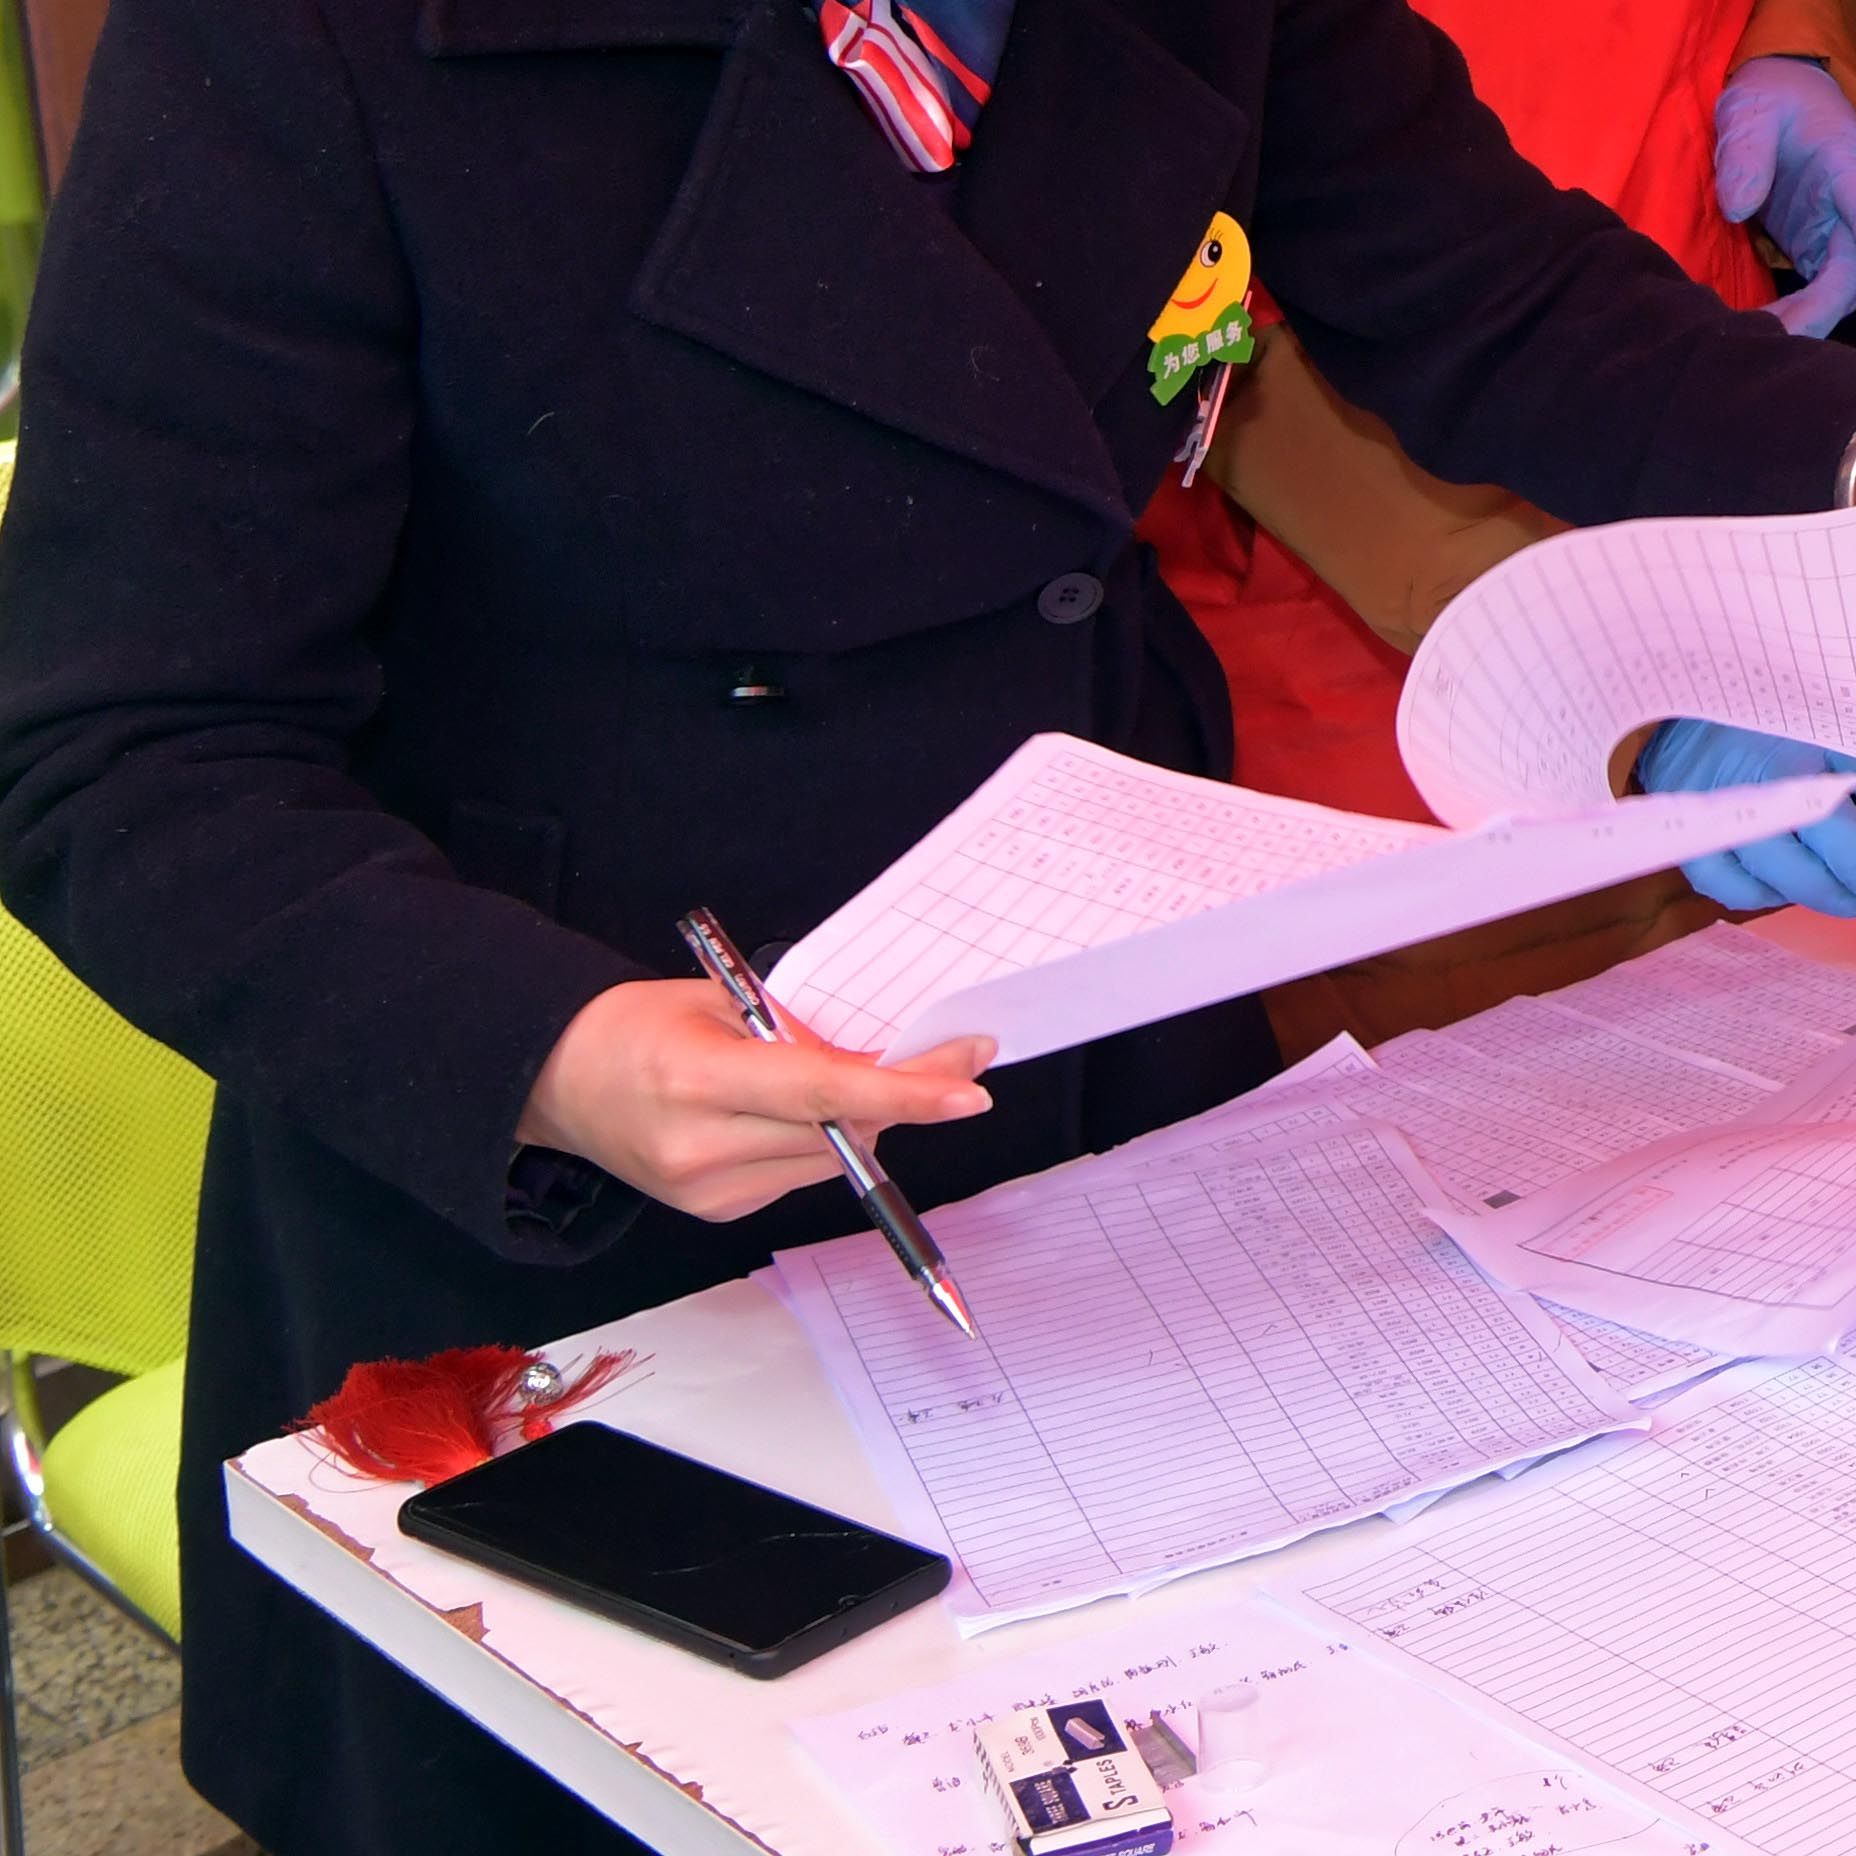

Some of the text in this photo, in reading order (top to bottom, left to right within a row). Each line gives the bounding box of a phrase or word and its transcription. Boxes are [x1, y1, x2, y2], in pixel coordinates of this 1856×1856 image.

[1163, 319, 1243, 380] 为您服务
[1095, 1758, 1139, 1812] STAPLES
